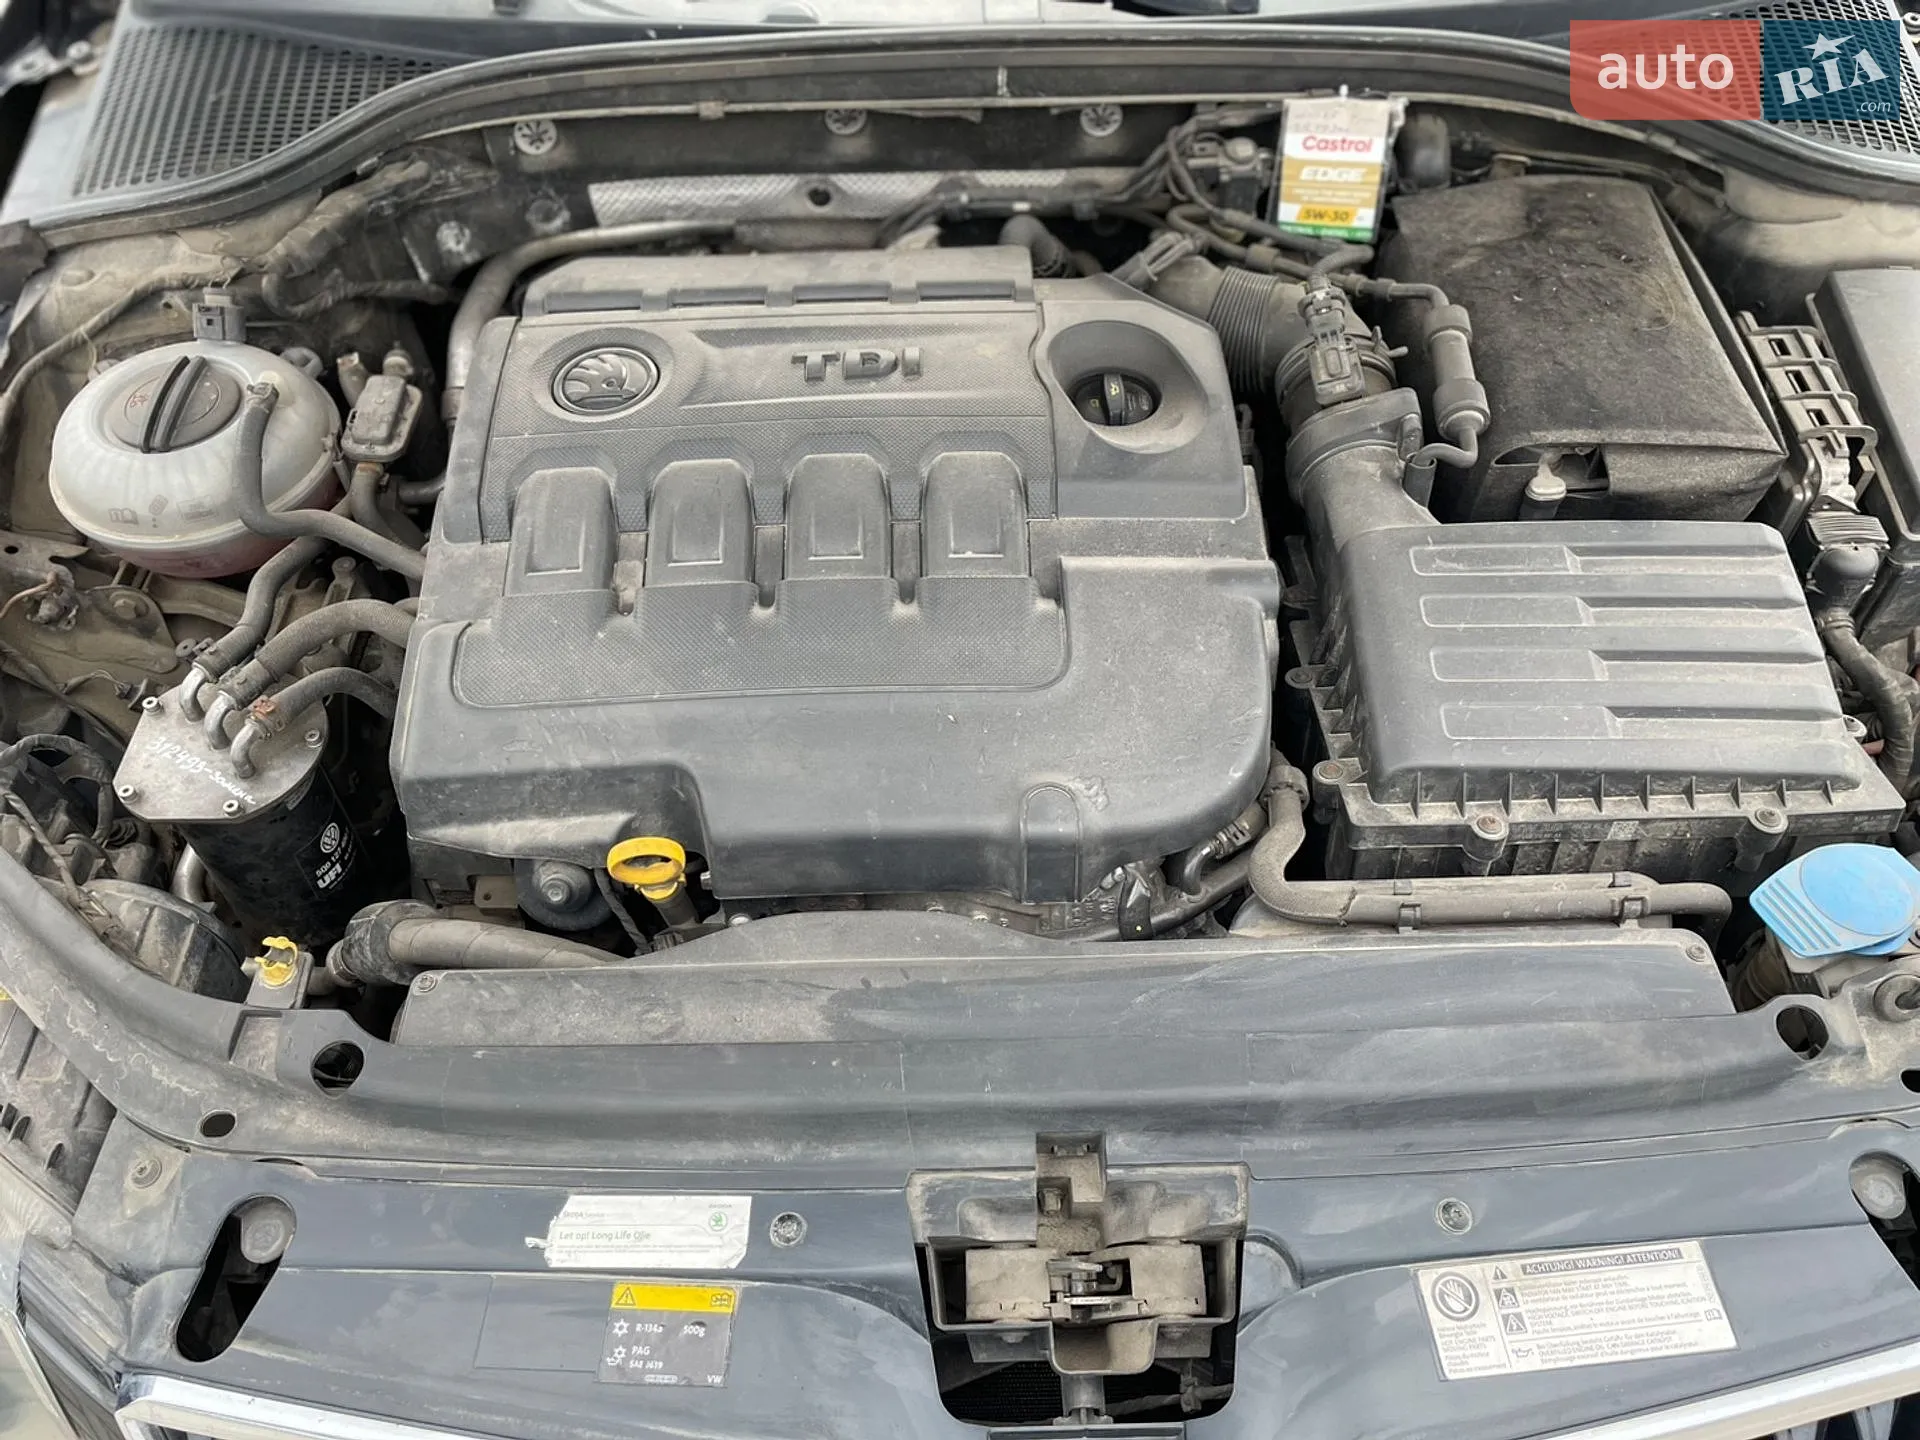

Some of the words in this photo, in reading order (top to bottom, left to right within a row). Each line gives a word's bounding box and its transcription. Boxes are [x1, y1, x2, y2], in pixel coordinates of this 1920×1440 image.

[1302, 135, 1374, 152] Castrol
[1303, 208, 1351, 223] 5W-30
[791, 347, 923, 382] TDI
[316, 863, 343, 889] UFI
[559, 1231, 574, 1240] Let
[591, 1231, 614, 1242] Long
[615, 1230, 632, 1240] Life
[1525, 1259, 1574, 1275] ACHTUNG!
[1576, 1254, 1625, 1269] WARNING!
[1626, 1248, 1682, 1264] ATTENTION!
[635, 1323, 664, 1333] R-134a
[683, 1324, 706, 1338] 500g
[631, 1345, 651, 1356] PAG
[629, 1360, 643, 1369] SAE
[707, 1375, 723, 1384] VW
